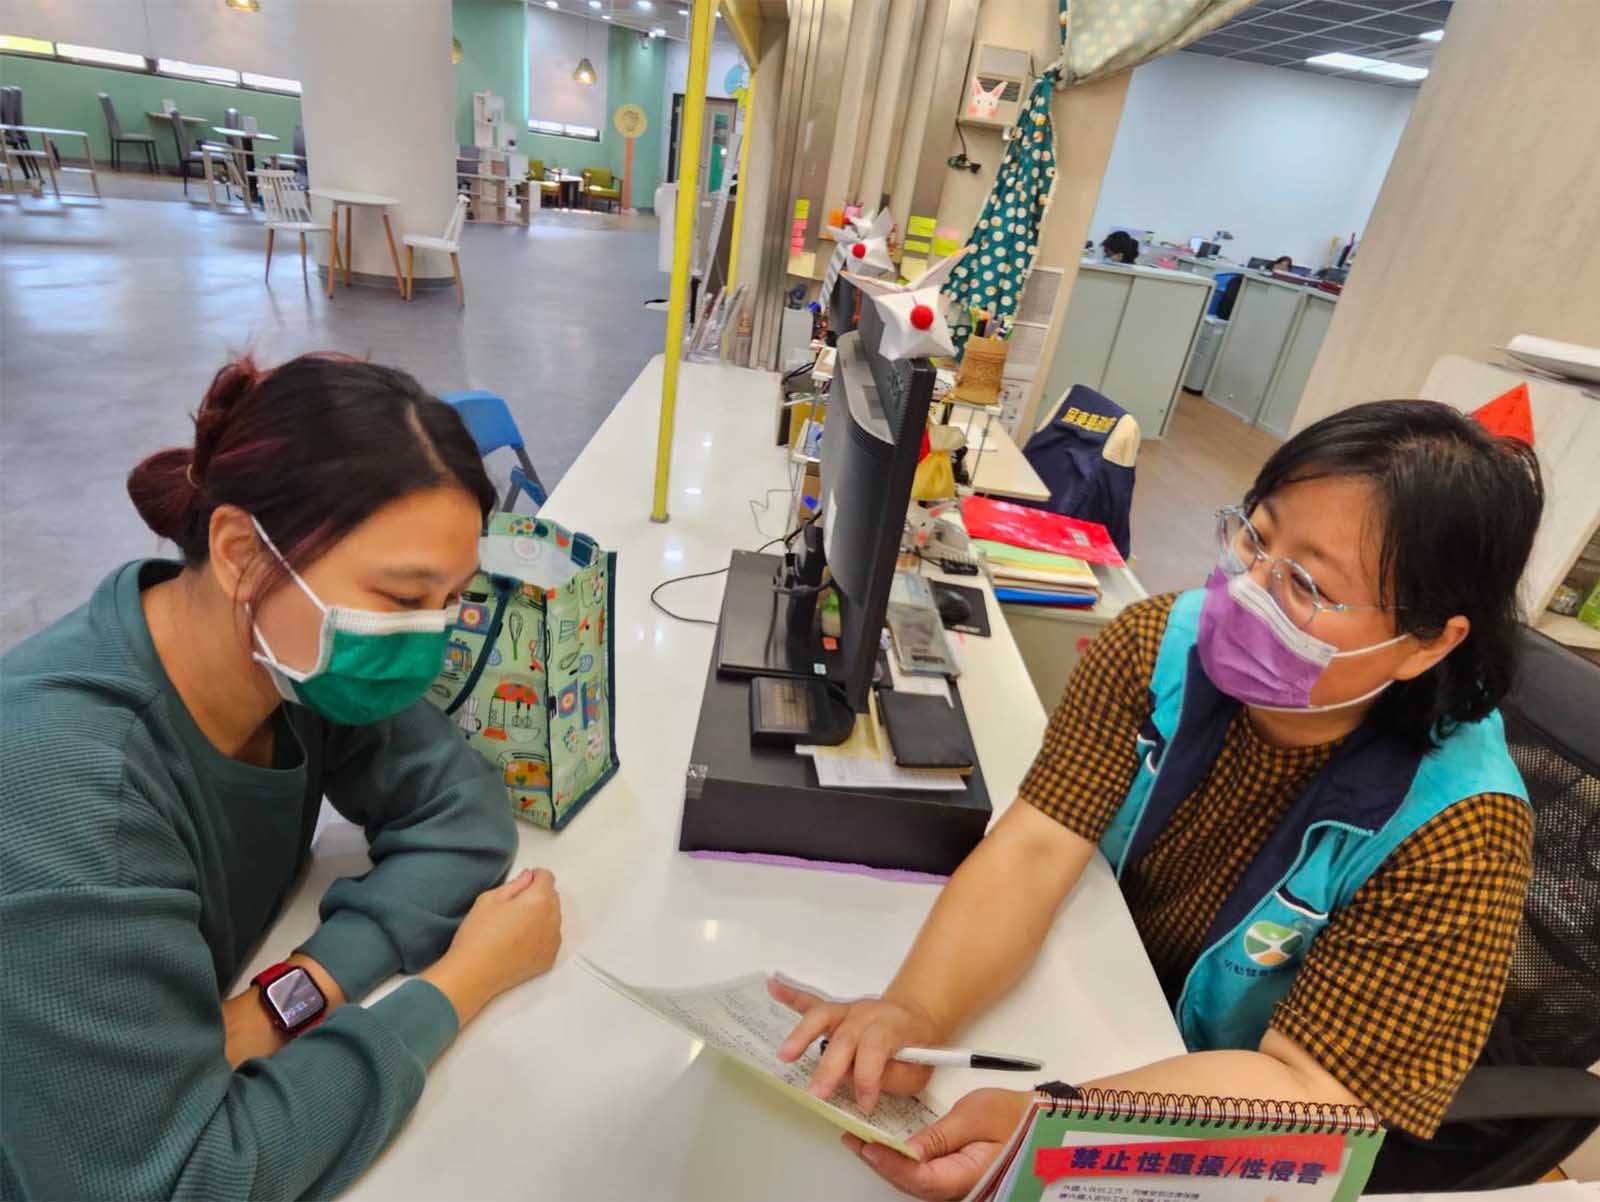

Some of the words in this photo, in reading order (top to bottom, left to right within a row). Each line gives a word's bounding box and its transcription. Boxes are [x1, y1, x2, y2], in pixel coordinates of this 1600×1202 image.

[1071, 1148, 1326, 1184] 禁止性騷擾/性侵害
